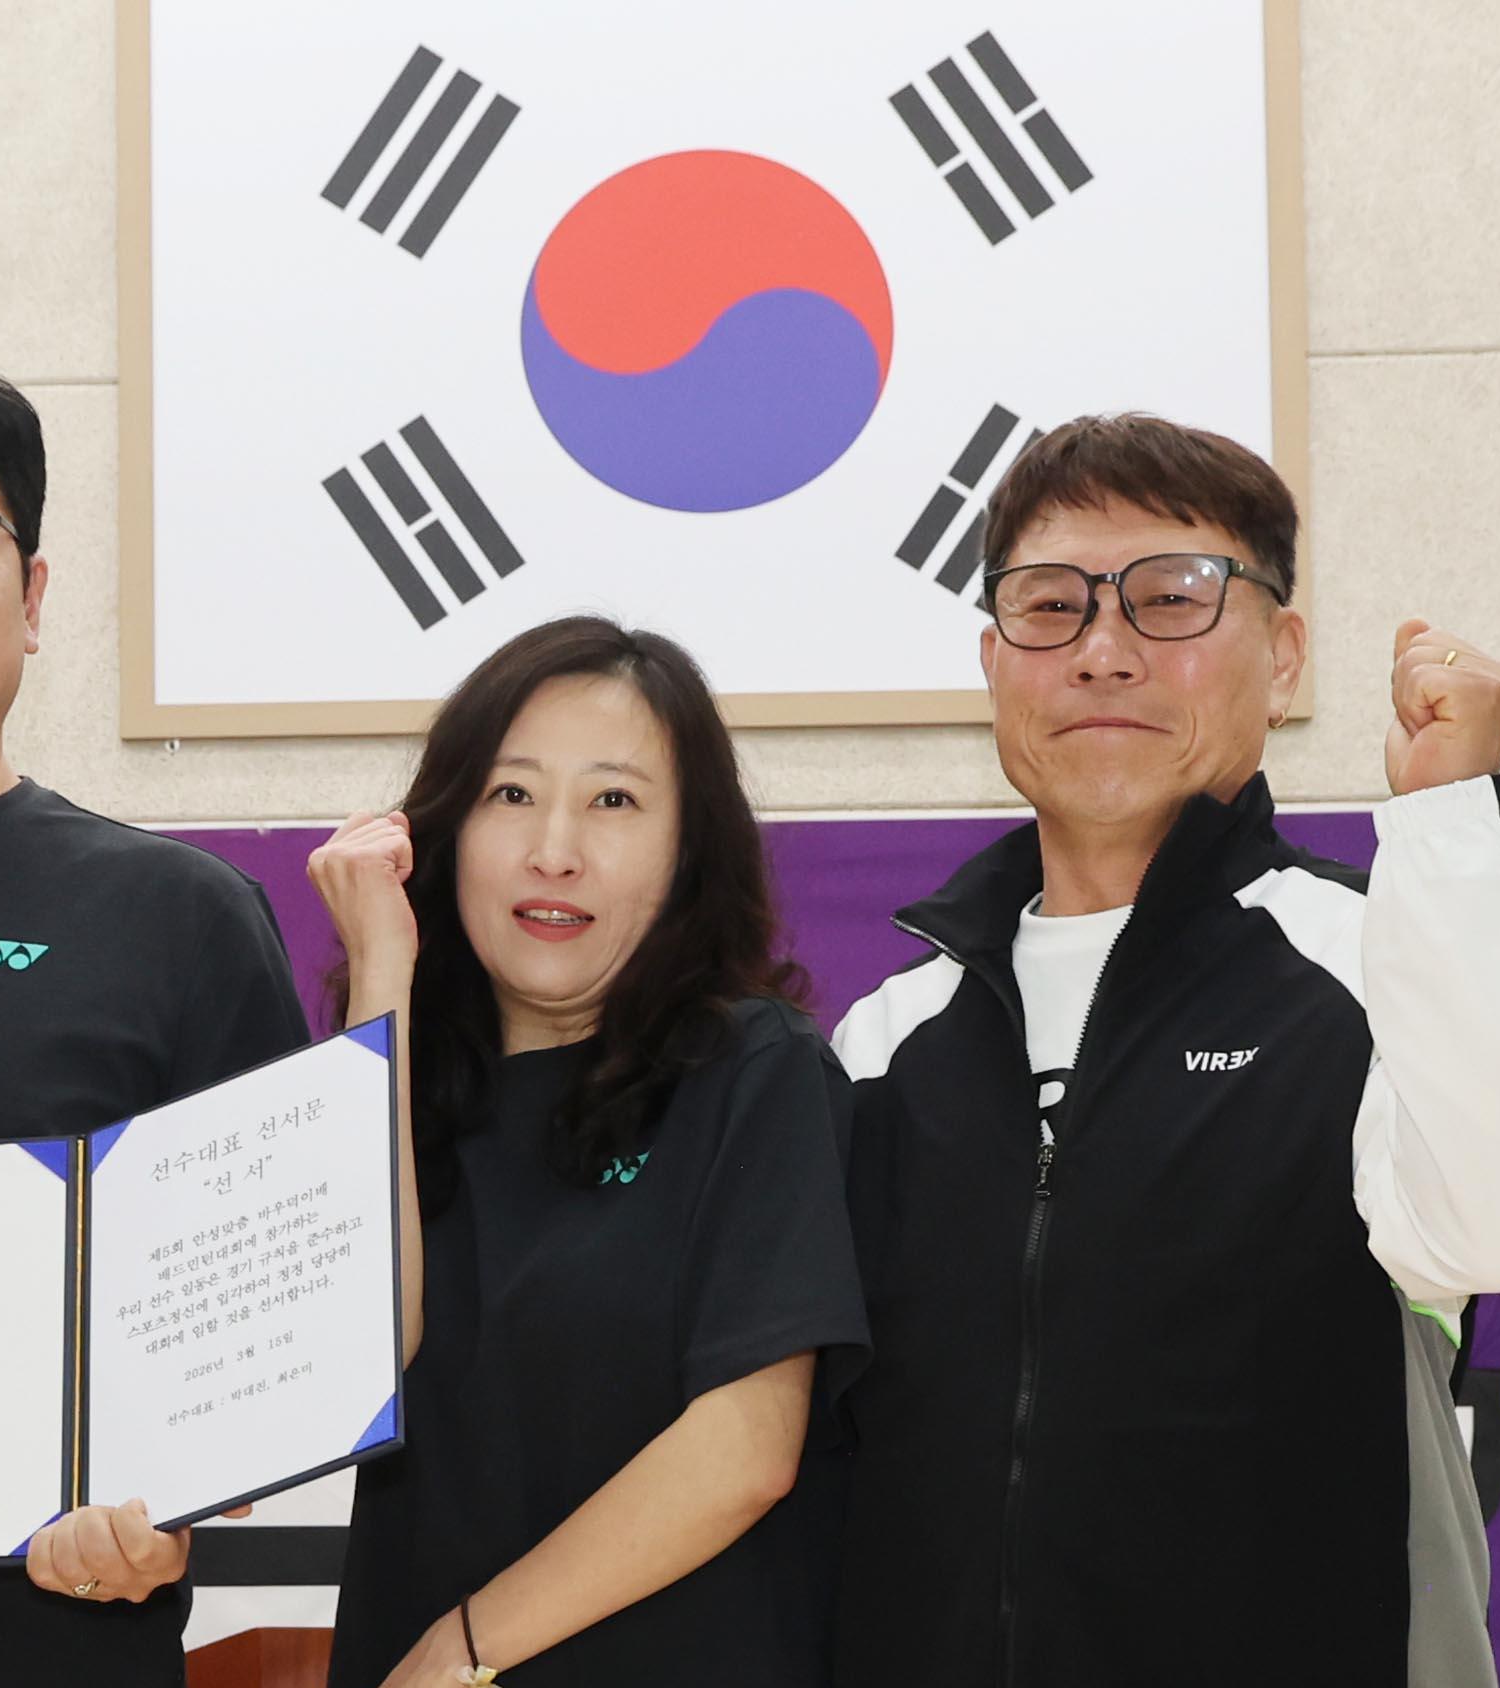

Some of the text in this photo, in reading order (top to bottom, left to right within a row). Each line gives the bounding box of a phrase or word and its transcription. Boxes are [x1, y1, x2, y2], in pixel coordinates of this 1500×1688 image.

[150, 1097, 326, 1183] 선수대표 선서문
[148, 1181, 329, 1264] 제5회 안성맞춤 바우덕이배
[157, 1209, 320, 1283] 배드민턴대회에 참가하는
[116, 1215, 364, 1322] 우리 선수 일동은 경기 규칙을 준수하고
[126, 1297, 210, 1340] 스포츠정신에
[216, 1273, 271, 1308] 입각하여
[310, 1241, 352, 1269] 당당히
[144, 1273, 336, 1356] 대회에 임할 것을 선서합니다.
[183, 1356, 225, 1382] 2026년
[267, 1329, 294, 1351] 15일
[167, 1399, 215, 1427] 선수대표
